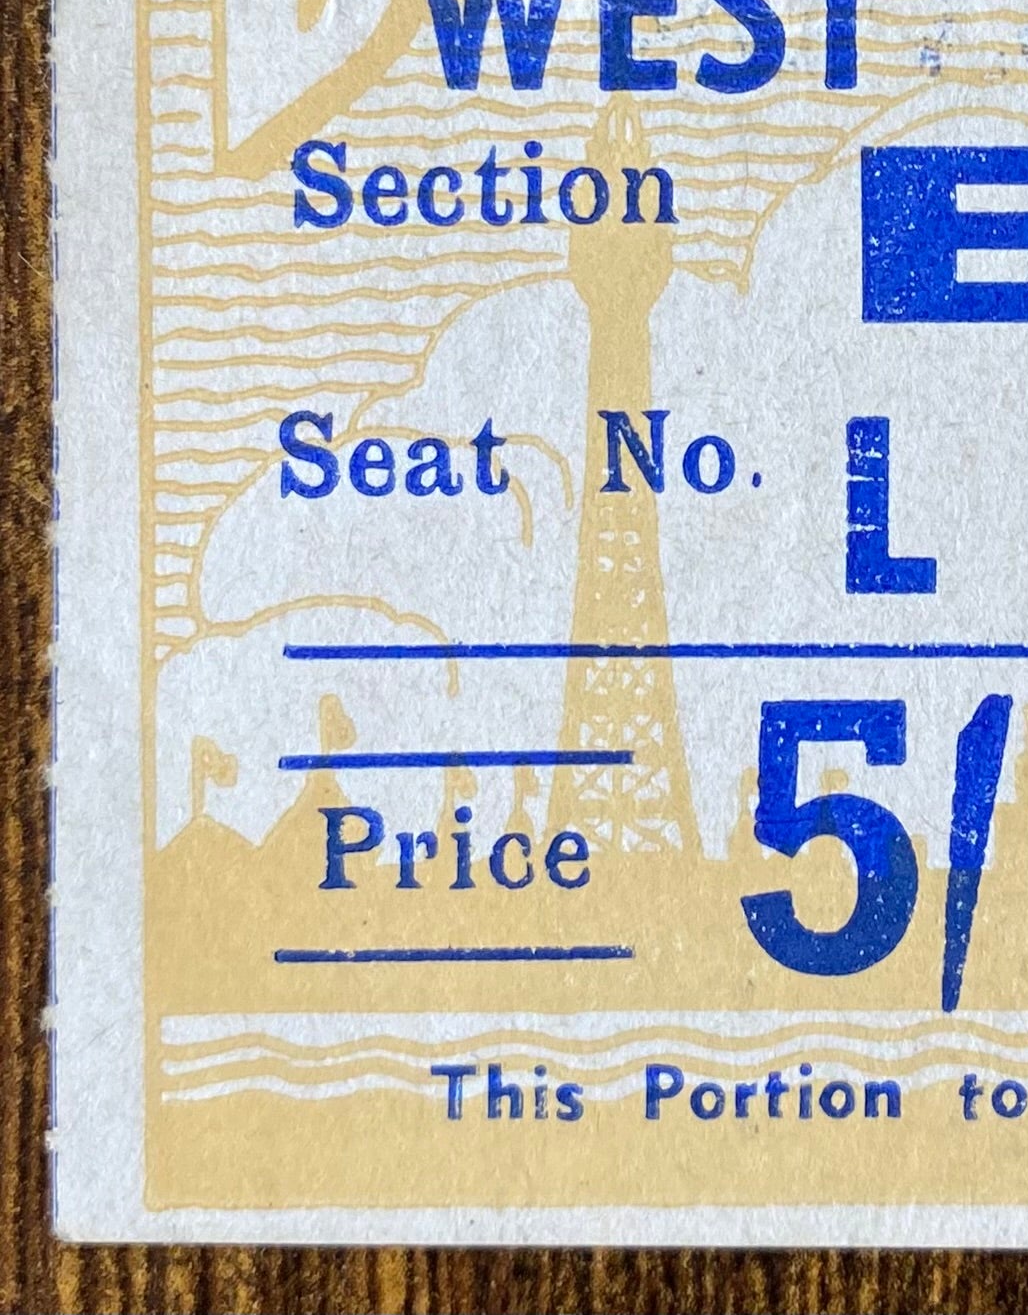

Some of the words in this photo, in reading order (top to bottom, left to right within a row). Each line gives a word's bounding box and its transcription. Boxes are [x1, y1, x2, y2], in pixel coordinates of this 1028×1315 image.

[290, 139, 681, 229] Section
[278, 410, 511, 500] Seat
[597, 409, 763, 495] No.
[845, 415, 938, 595] L
[318, 804, 591, 890] Price
[430, 1063, 584, 1122] This
[645, 1063, 902, 1121] Portion
[958, 1073, 1028, 1121] to
